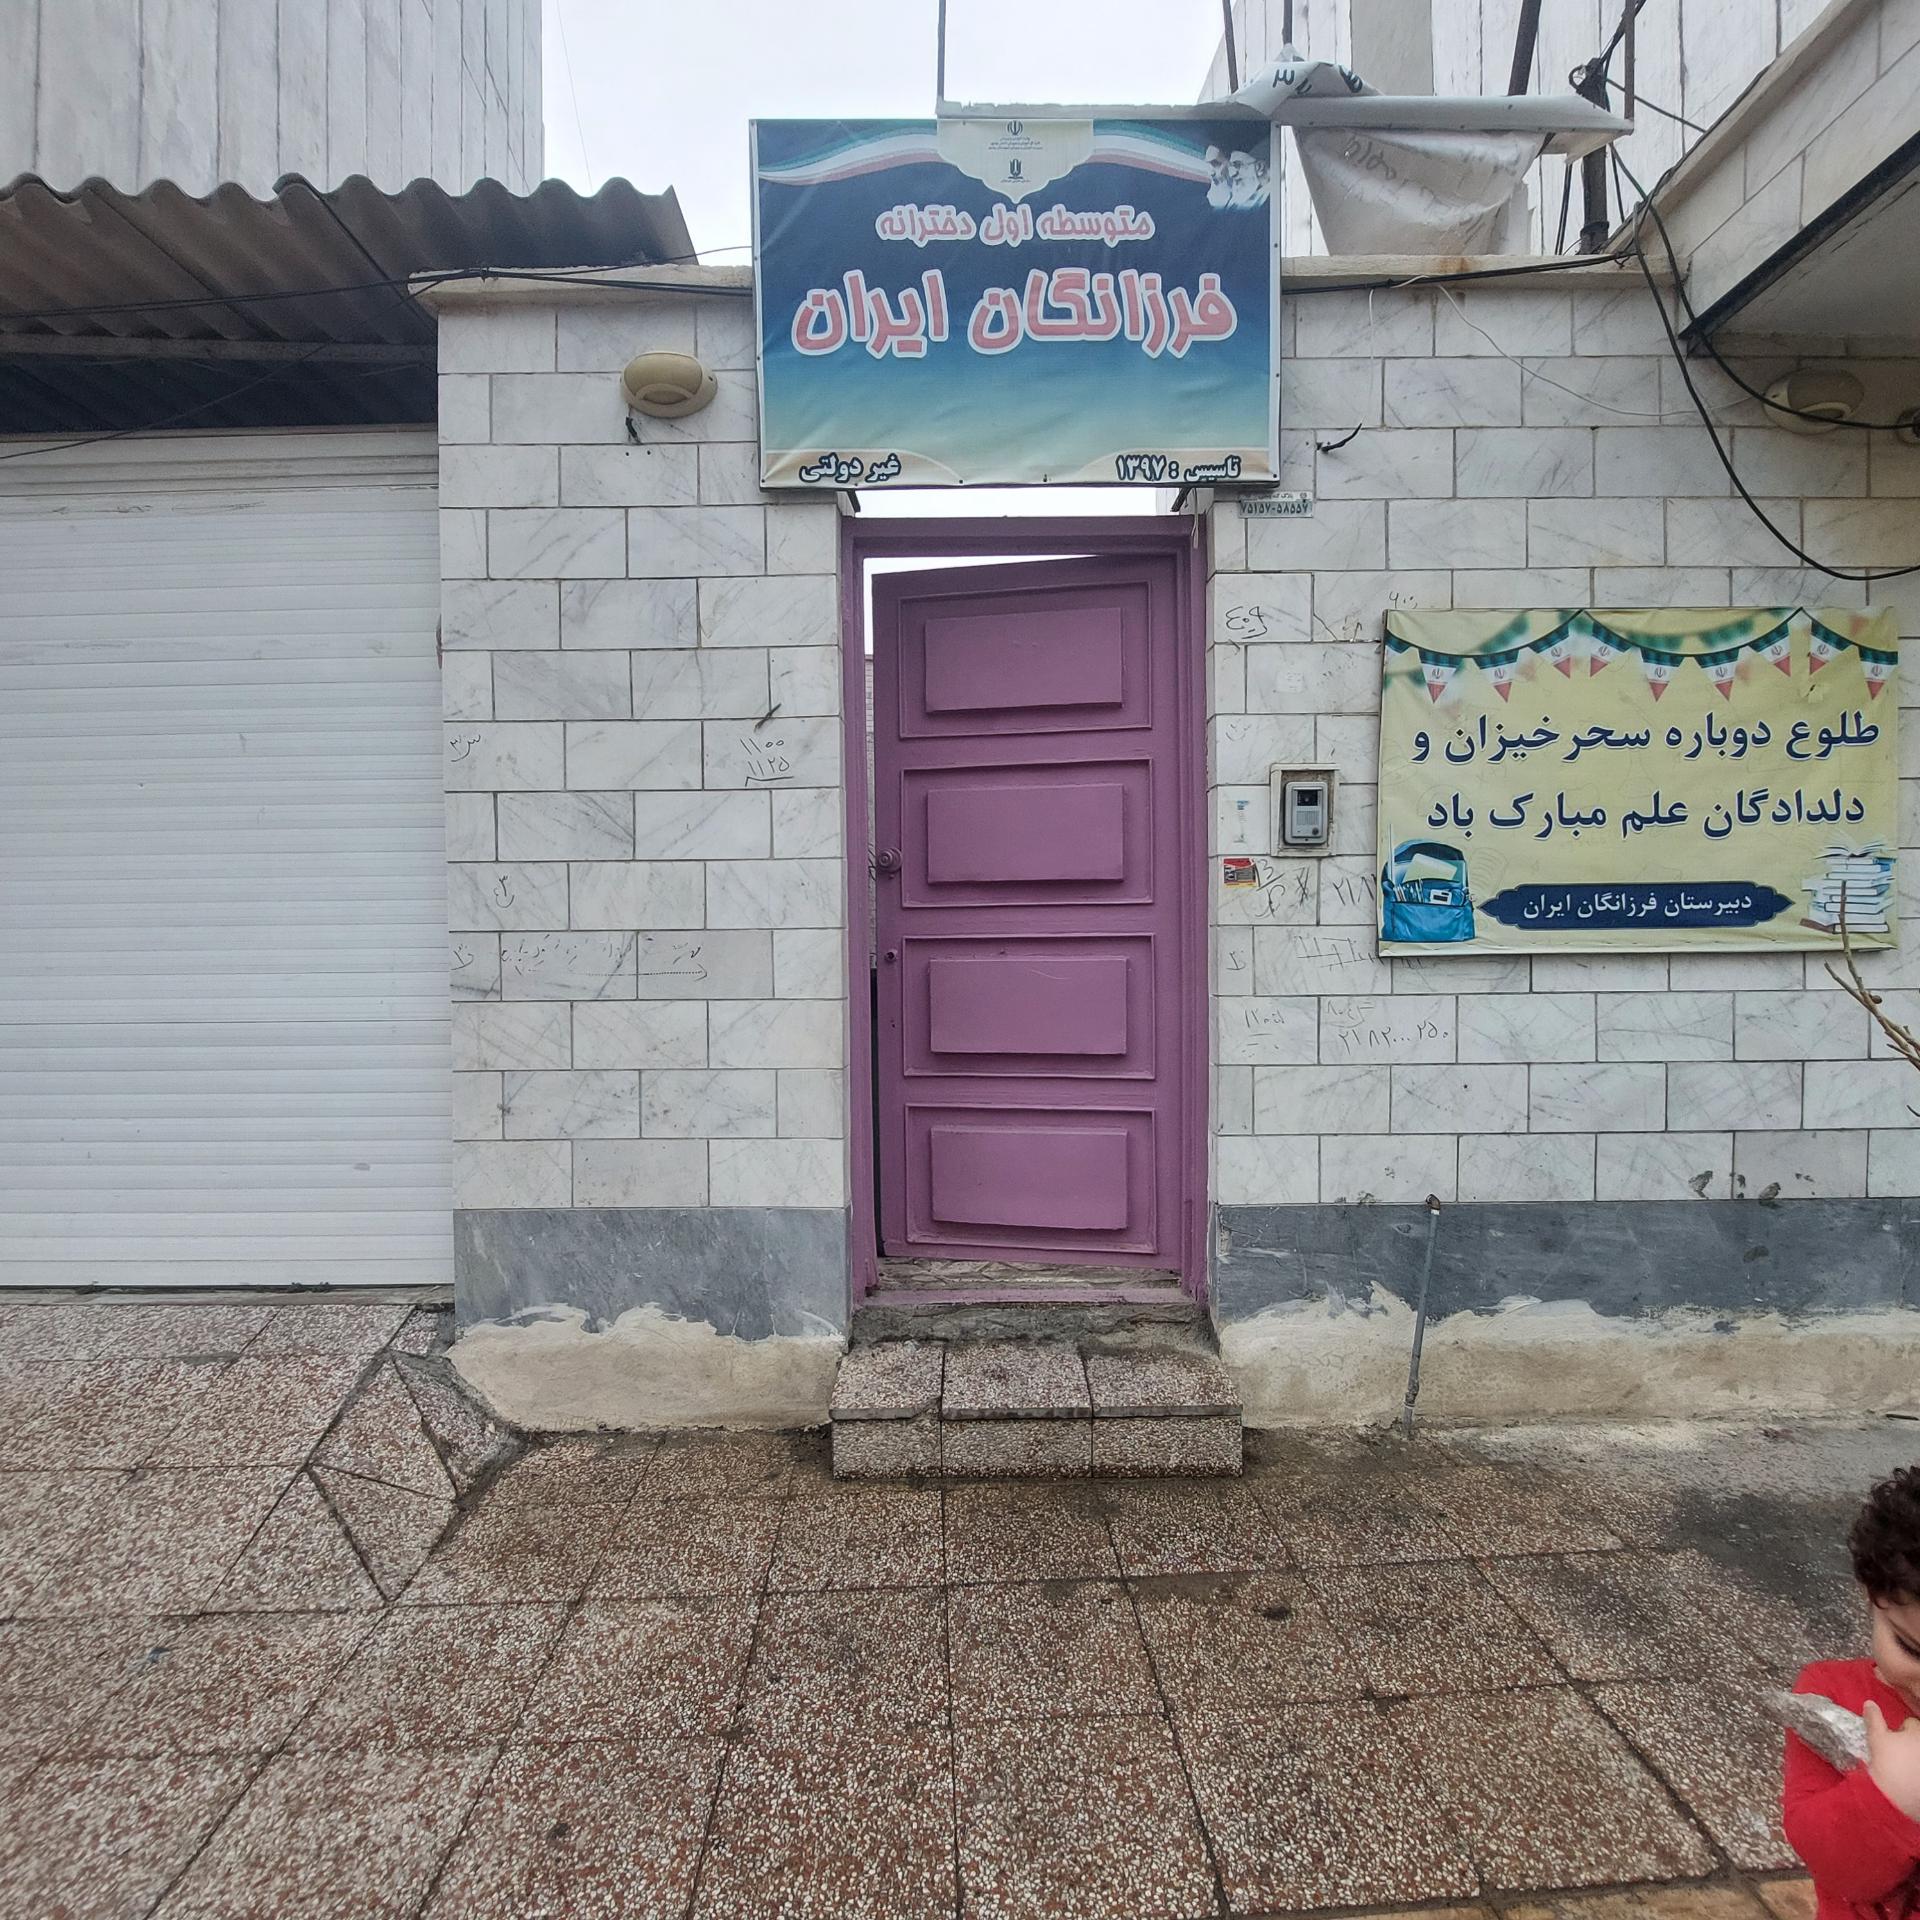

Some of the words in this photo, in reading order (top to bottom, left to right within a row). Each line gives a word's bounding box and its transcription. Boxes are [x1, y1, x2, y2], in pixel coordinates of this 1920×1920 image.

[875, 203, 977, 248] دخترانه
[980, 202, 1034, 248] اول
[1036, 203, 1155, 248] متوسطه
[791, 268, 948, 359] ایران
[967, 267, 1237, 359] فرزانگان
[799, 452, 864, 483] دولتی
[865, 452, 902, 482] غیر
[1115, 454, 1167, 481] ۱۳۹۷
[1185, 455, 1241, 481] تاسیس
[1411, 730, 1431, 763] و
[1665, 711, 1773, 761] دوباره
[1785, 710, 1880, 761] طلوع
[1427, 791, 1474, 840] باد
[1488, 791, 1607, 840] مبارک
[1621, 789, 1689, 839] علم
[1703, 787, 1865, 840] دلدادگان
[1523, 893, 1571, 919] ایران
[1576, 891, 1657, 919] فرزانگان
[1664, 892, 1753, 918] دبیرستان
